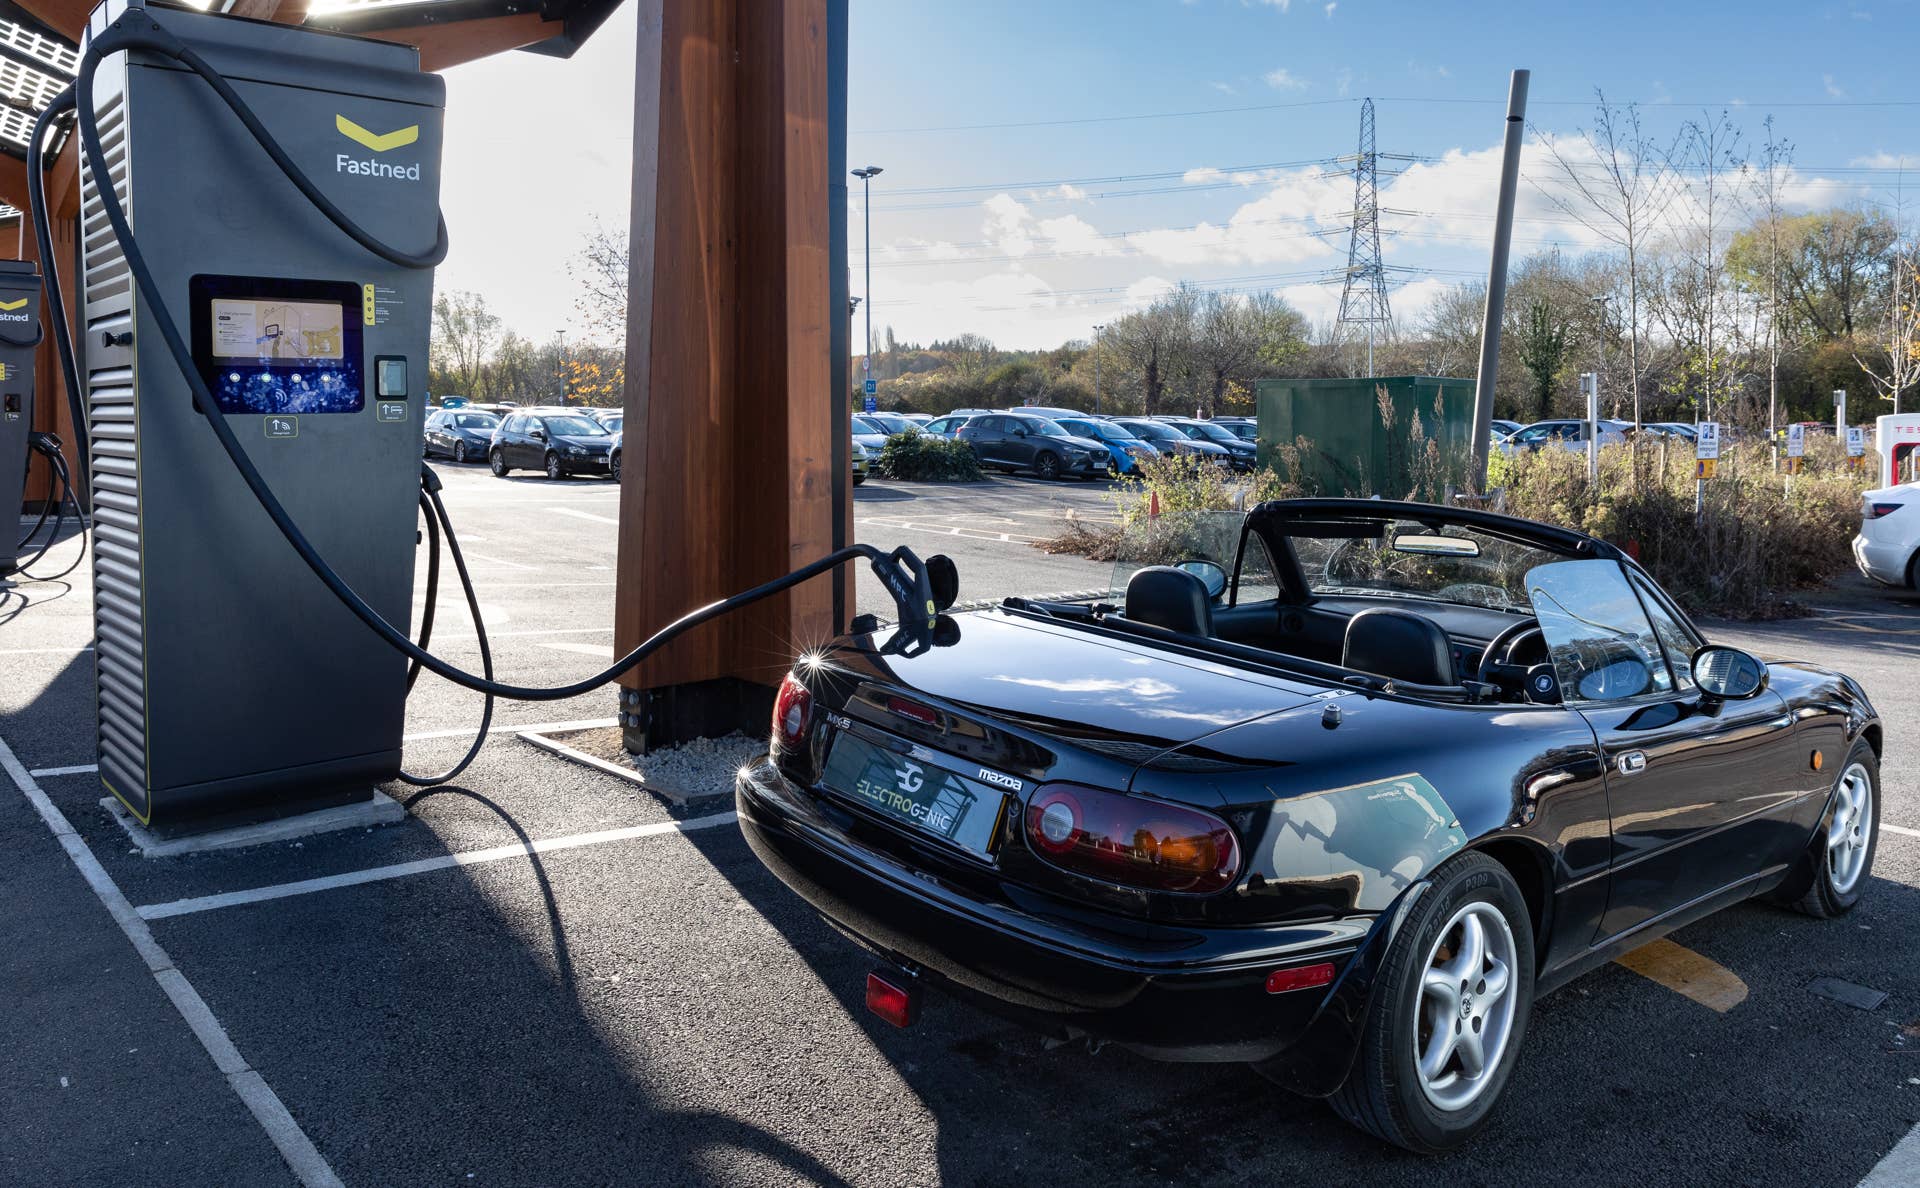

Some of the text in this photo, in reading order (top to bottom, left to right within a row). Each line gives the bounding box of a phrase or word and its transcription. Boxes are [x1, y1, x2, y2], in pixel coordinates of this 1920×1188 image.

[336, 154, 420, 181] Fastned
[978, 768, 1024, 792] mazda
[856, 778, 953, 831] ELECTROGENIC
[1465, 873, 1488, 892] P309
